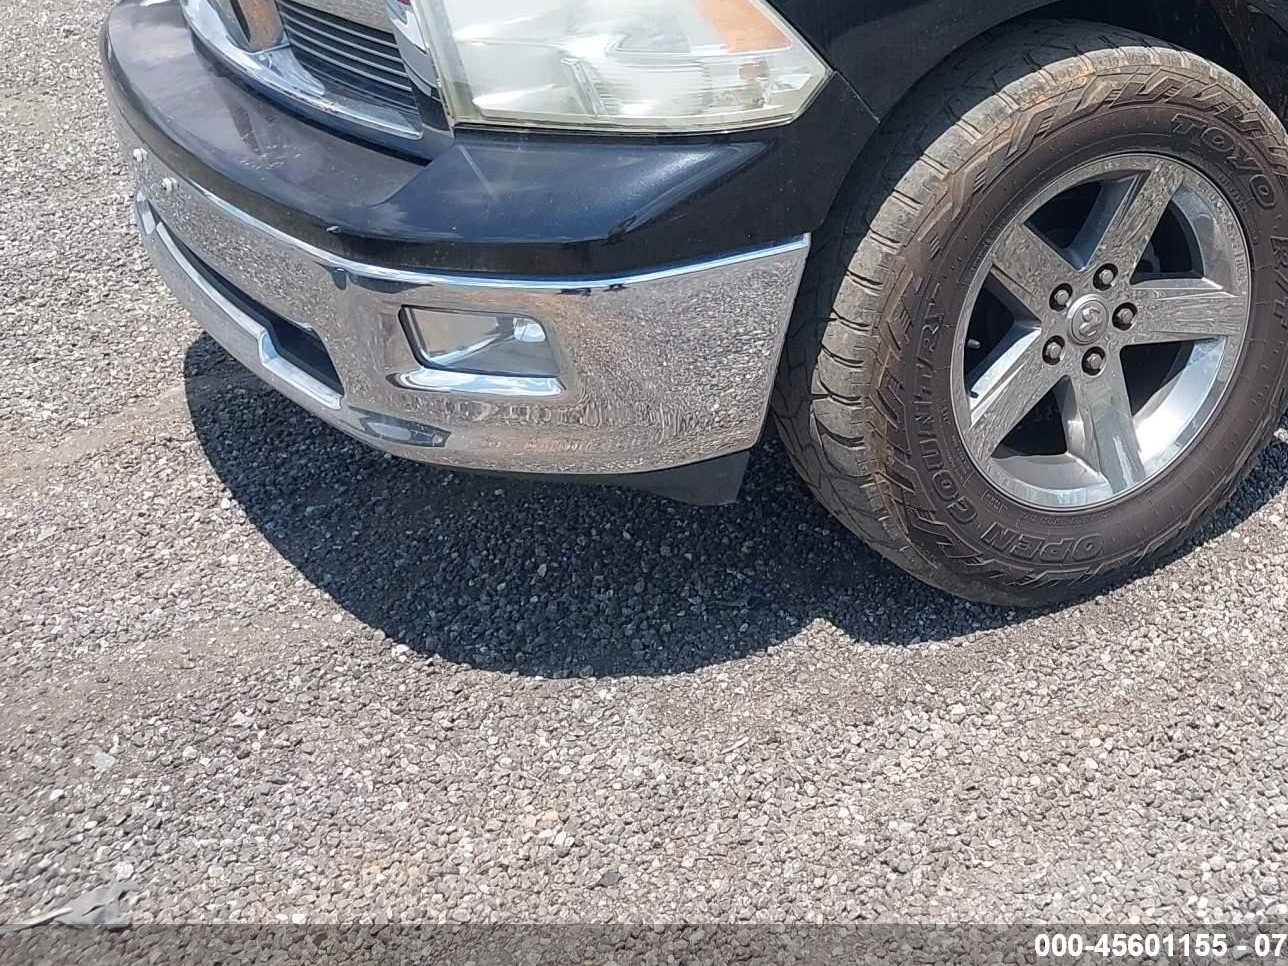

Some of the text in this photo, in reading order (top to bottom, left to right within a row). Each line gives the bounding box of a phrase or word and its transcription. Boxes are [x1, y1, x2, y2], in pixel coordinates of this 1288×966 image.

[1170, 112, 1277, 210] TOYO
[912, 282, 979, 525] COUNTRY
[980, 521, 1104, 563] OPEN
